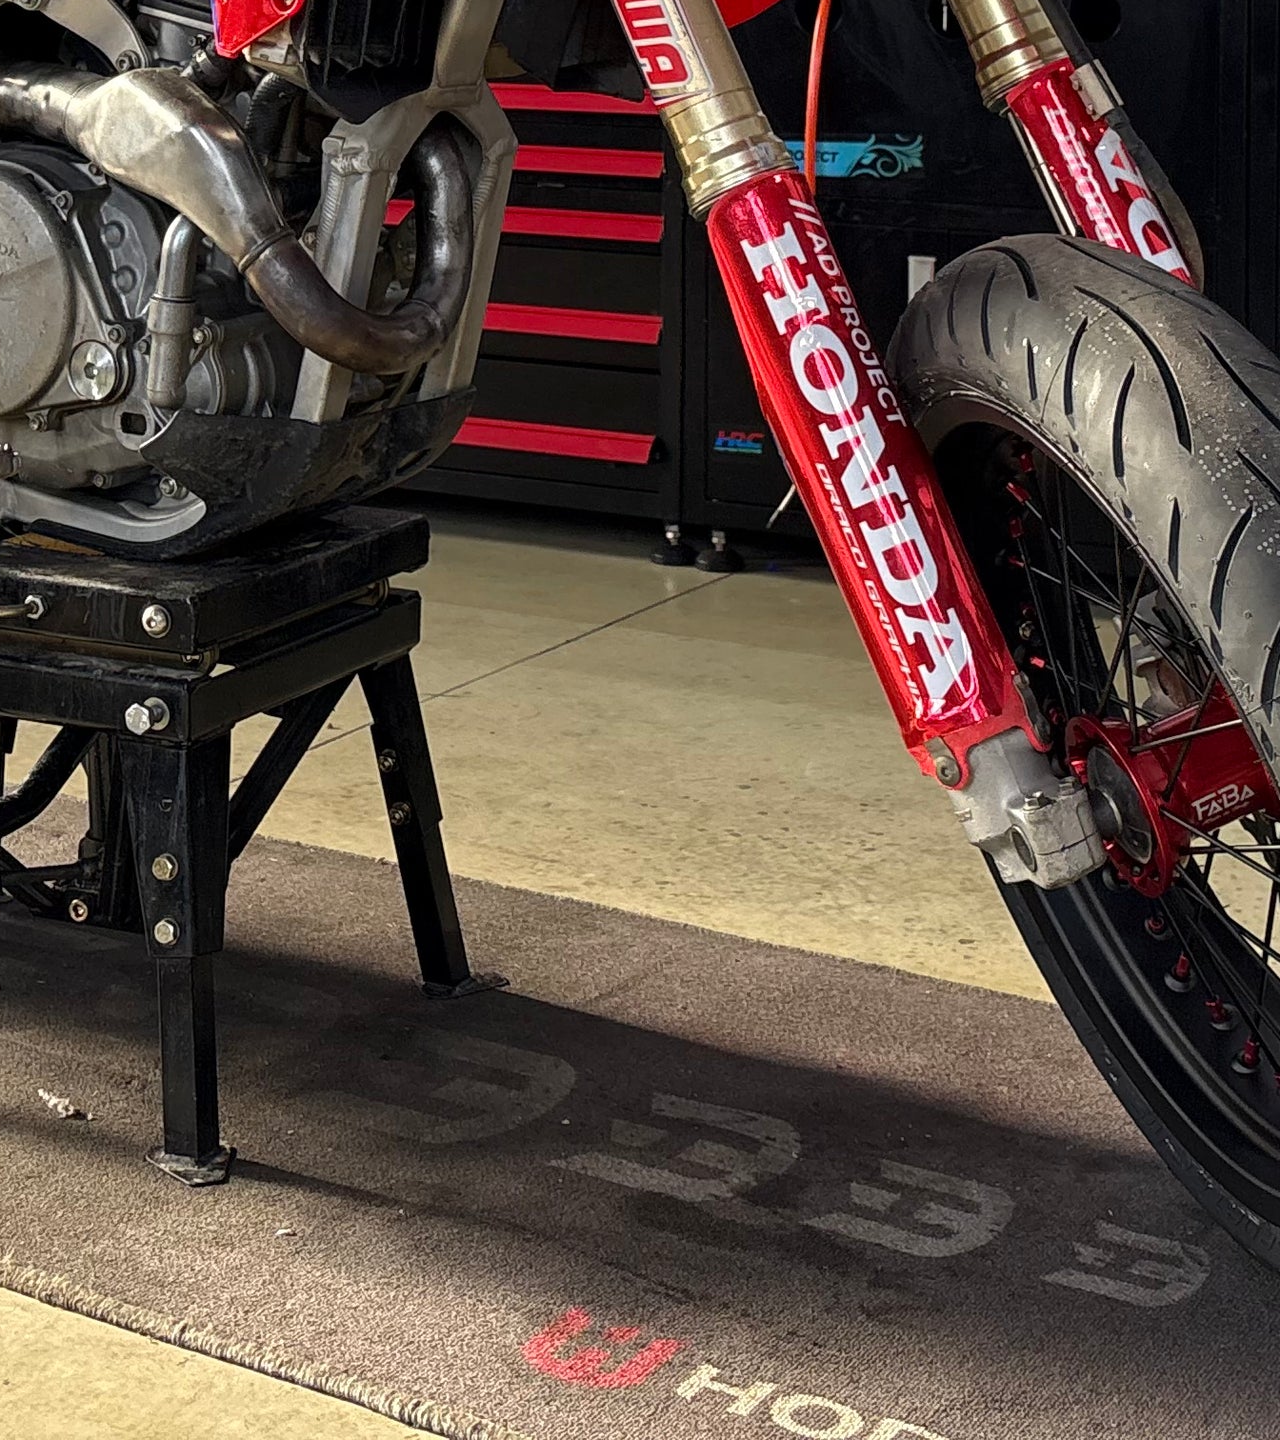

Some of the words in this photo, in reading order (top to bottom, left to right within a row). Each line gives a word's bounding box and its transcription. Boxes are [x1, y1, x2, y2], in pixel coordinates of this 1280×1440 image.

[740, 220, 975, 716] HONDA
[832, 284, 908, 429] PROJECT
[815, 462, 868, 570] DRACO
[863, 578, 924, 720] GRAPHIX
